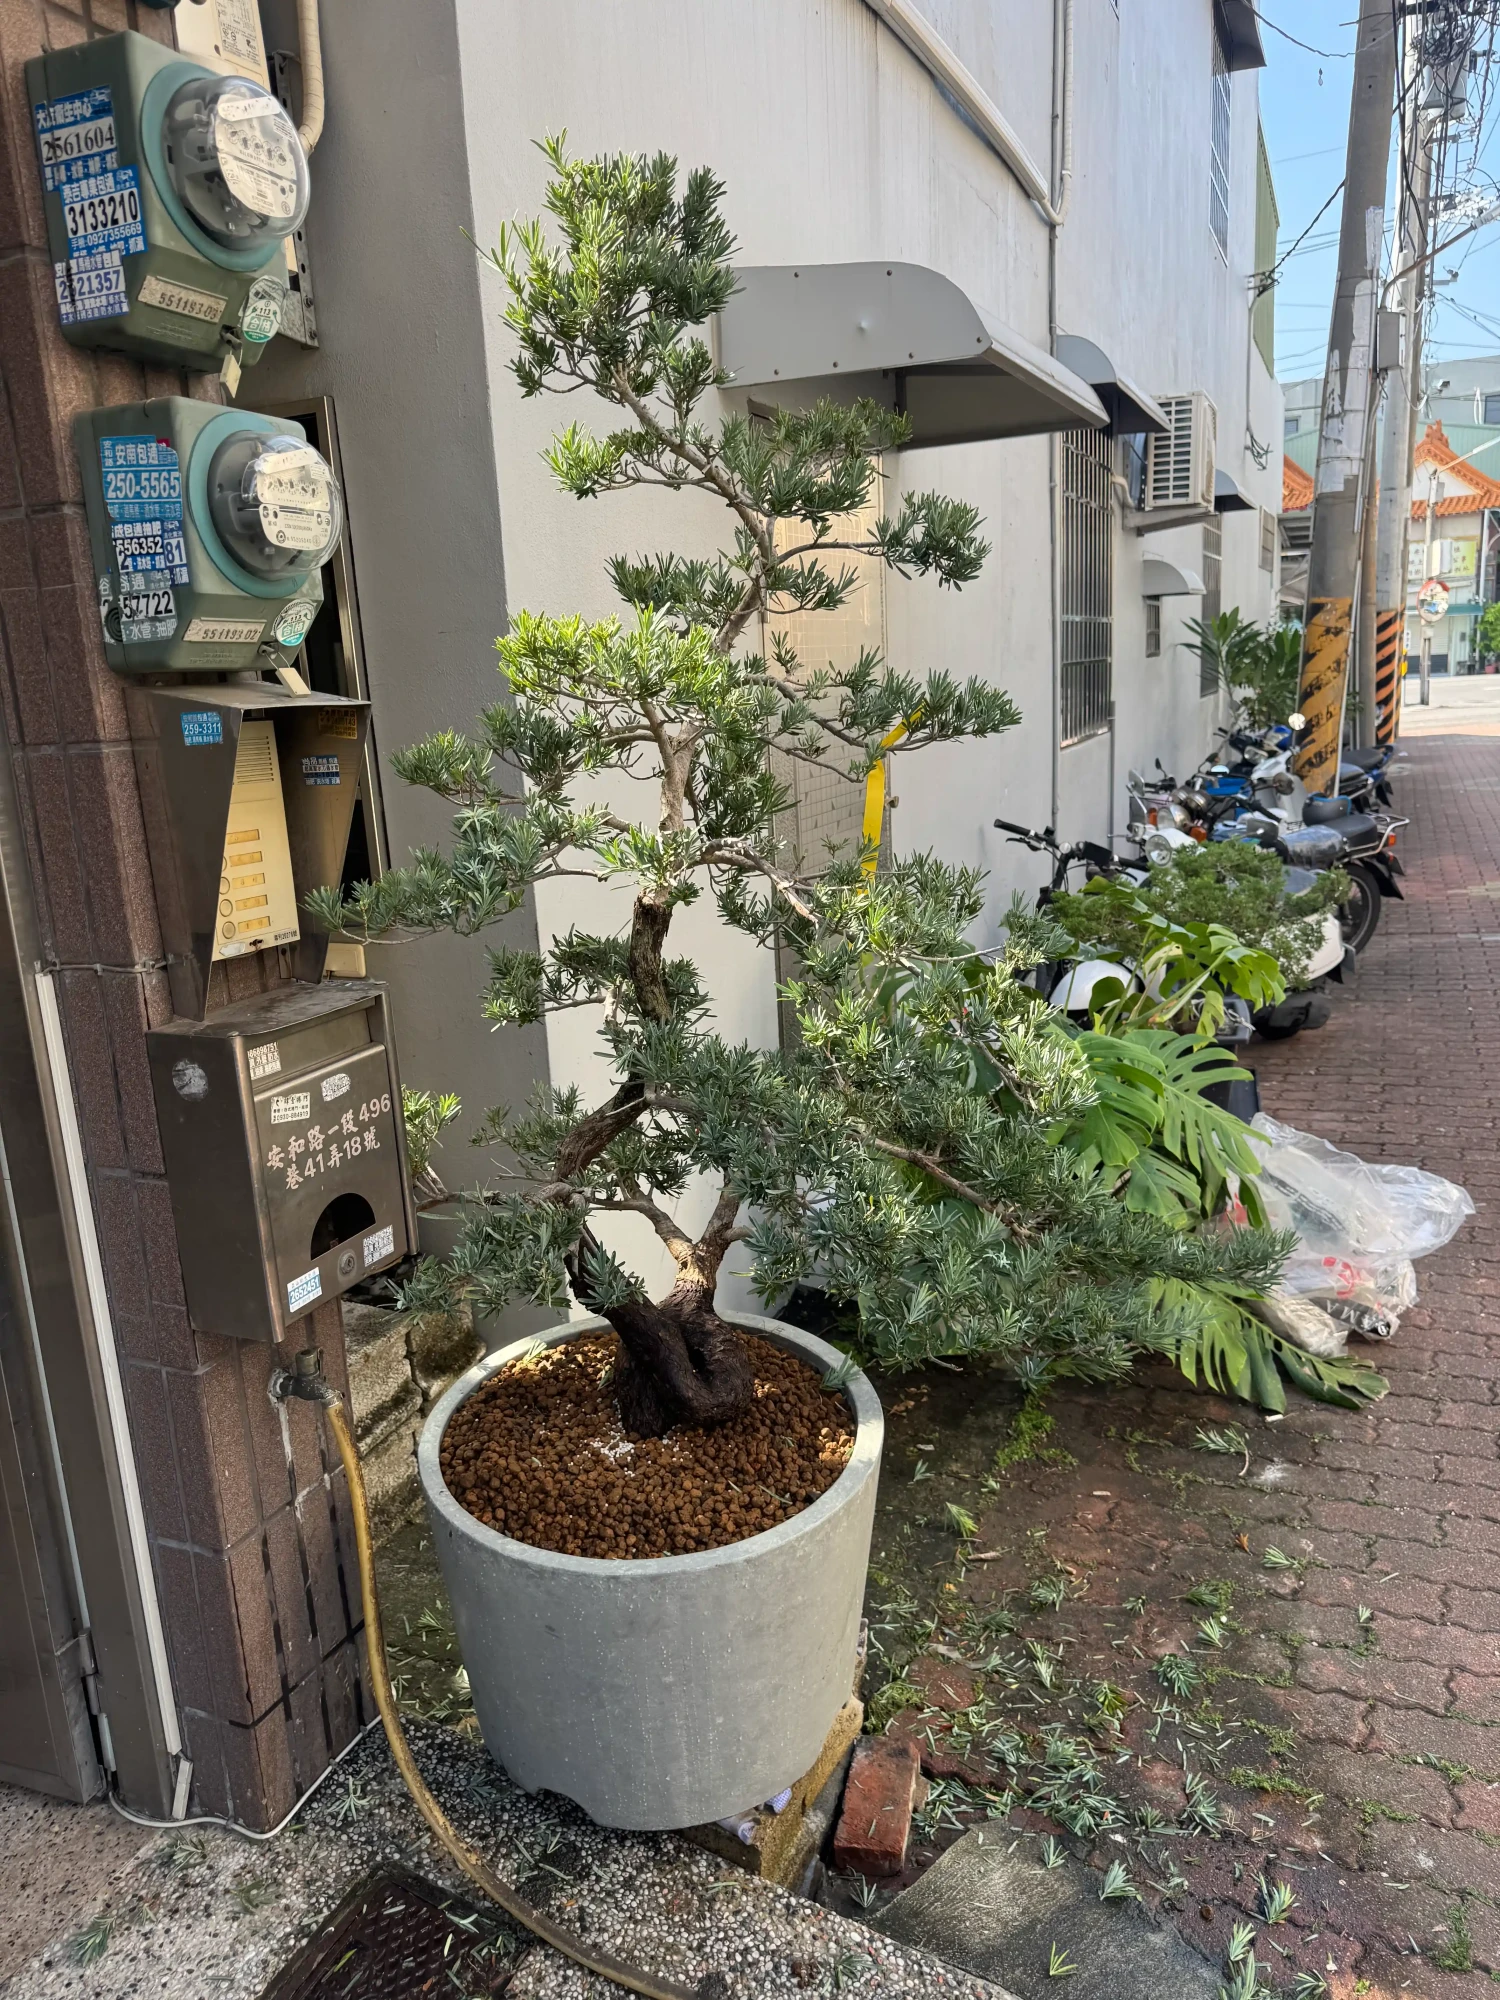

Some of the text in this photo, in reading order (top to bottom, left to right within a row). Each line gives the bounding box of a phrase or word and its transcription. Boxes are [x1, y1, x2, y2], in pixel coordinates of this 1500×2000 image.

[43, 123, 115, 162] 2561604
[67, 190, 138, 236] 3133210
[59, 269, 121, 301] 221357
[249, 315, 274, 334] 合格
[115, 443, 159, 466] 安南包通
[107, 471, 181, 499] 250-5565
[111, 520, 162, 539] 成包通抽肥
[184, 722, 222, 735] 259-3311
[266, 1093, 391, 1174] 安和路一段496
[285, 1126, 381, 1190] 巷41弄18號
[290, 1277, 321, 1303] 2652451
